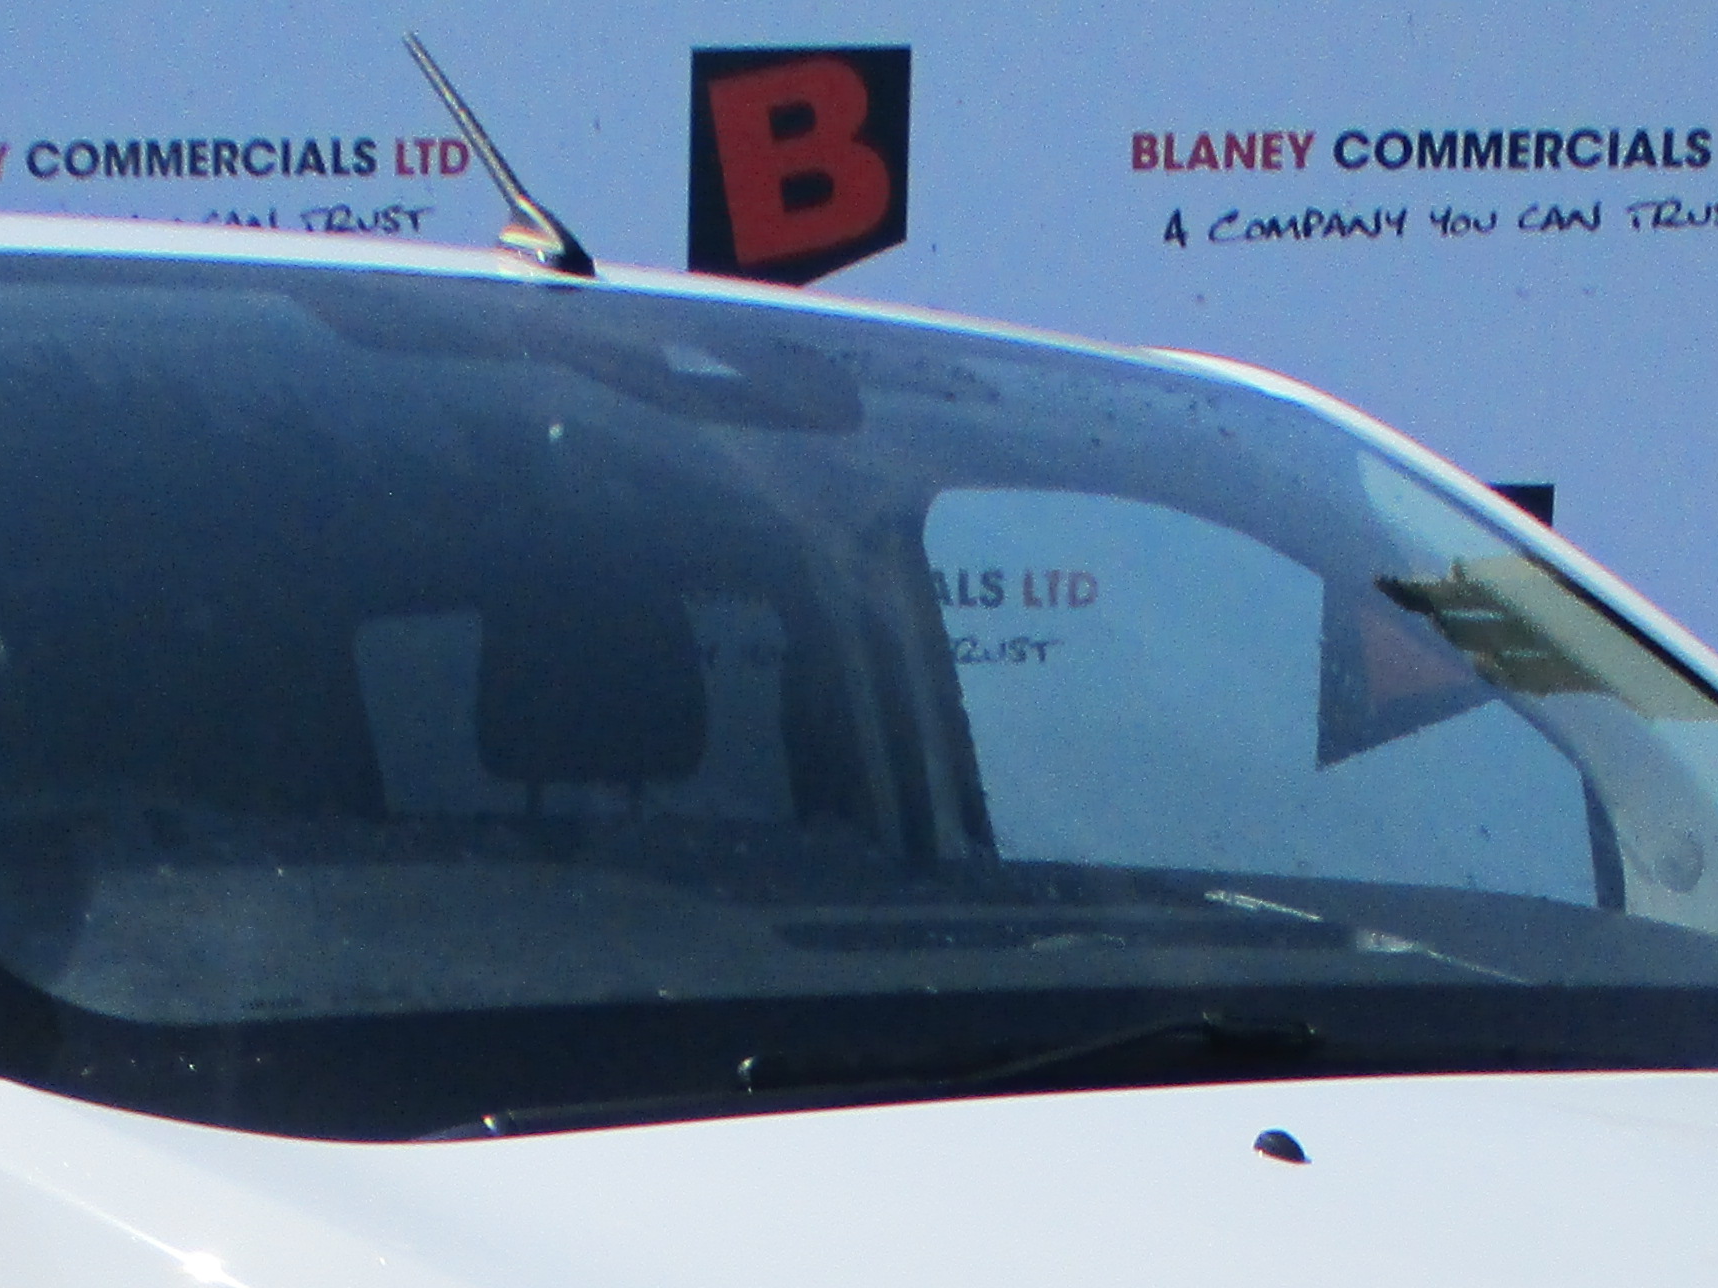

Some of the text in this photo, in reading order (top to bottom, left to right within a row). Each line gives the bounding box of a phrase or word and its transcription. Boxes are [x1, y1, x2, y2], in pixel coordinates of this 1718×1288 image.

[25, 137, 377, 179] COMMERCIALS
[394, 137, 470, 177] LTD
[707, 54, 891, 267] B
[1131, 131, 1317, 172] BLANEY
[1333, 128, 1713, 171] COMMERCIALS
[1164, 208, 1189, 248] A
[1208, 208, 1407, 245] COMPANY
[1430, 207, 1497, 238] YOU
[1518, 201, 1601, 233] CAN
[1022, 569, 1099, 609] LTD
[954, 636, 1065, 665] RUST
